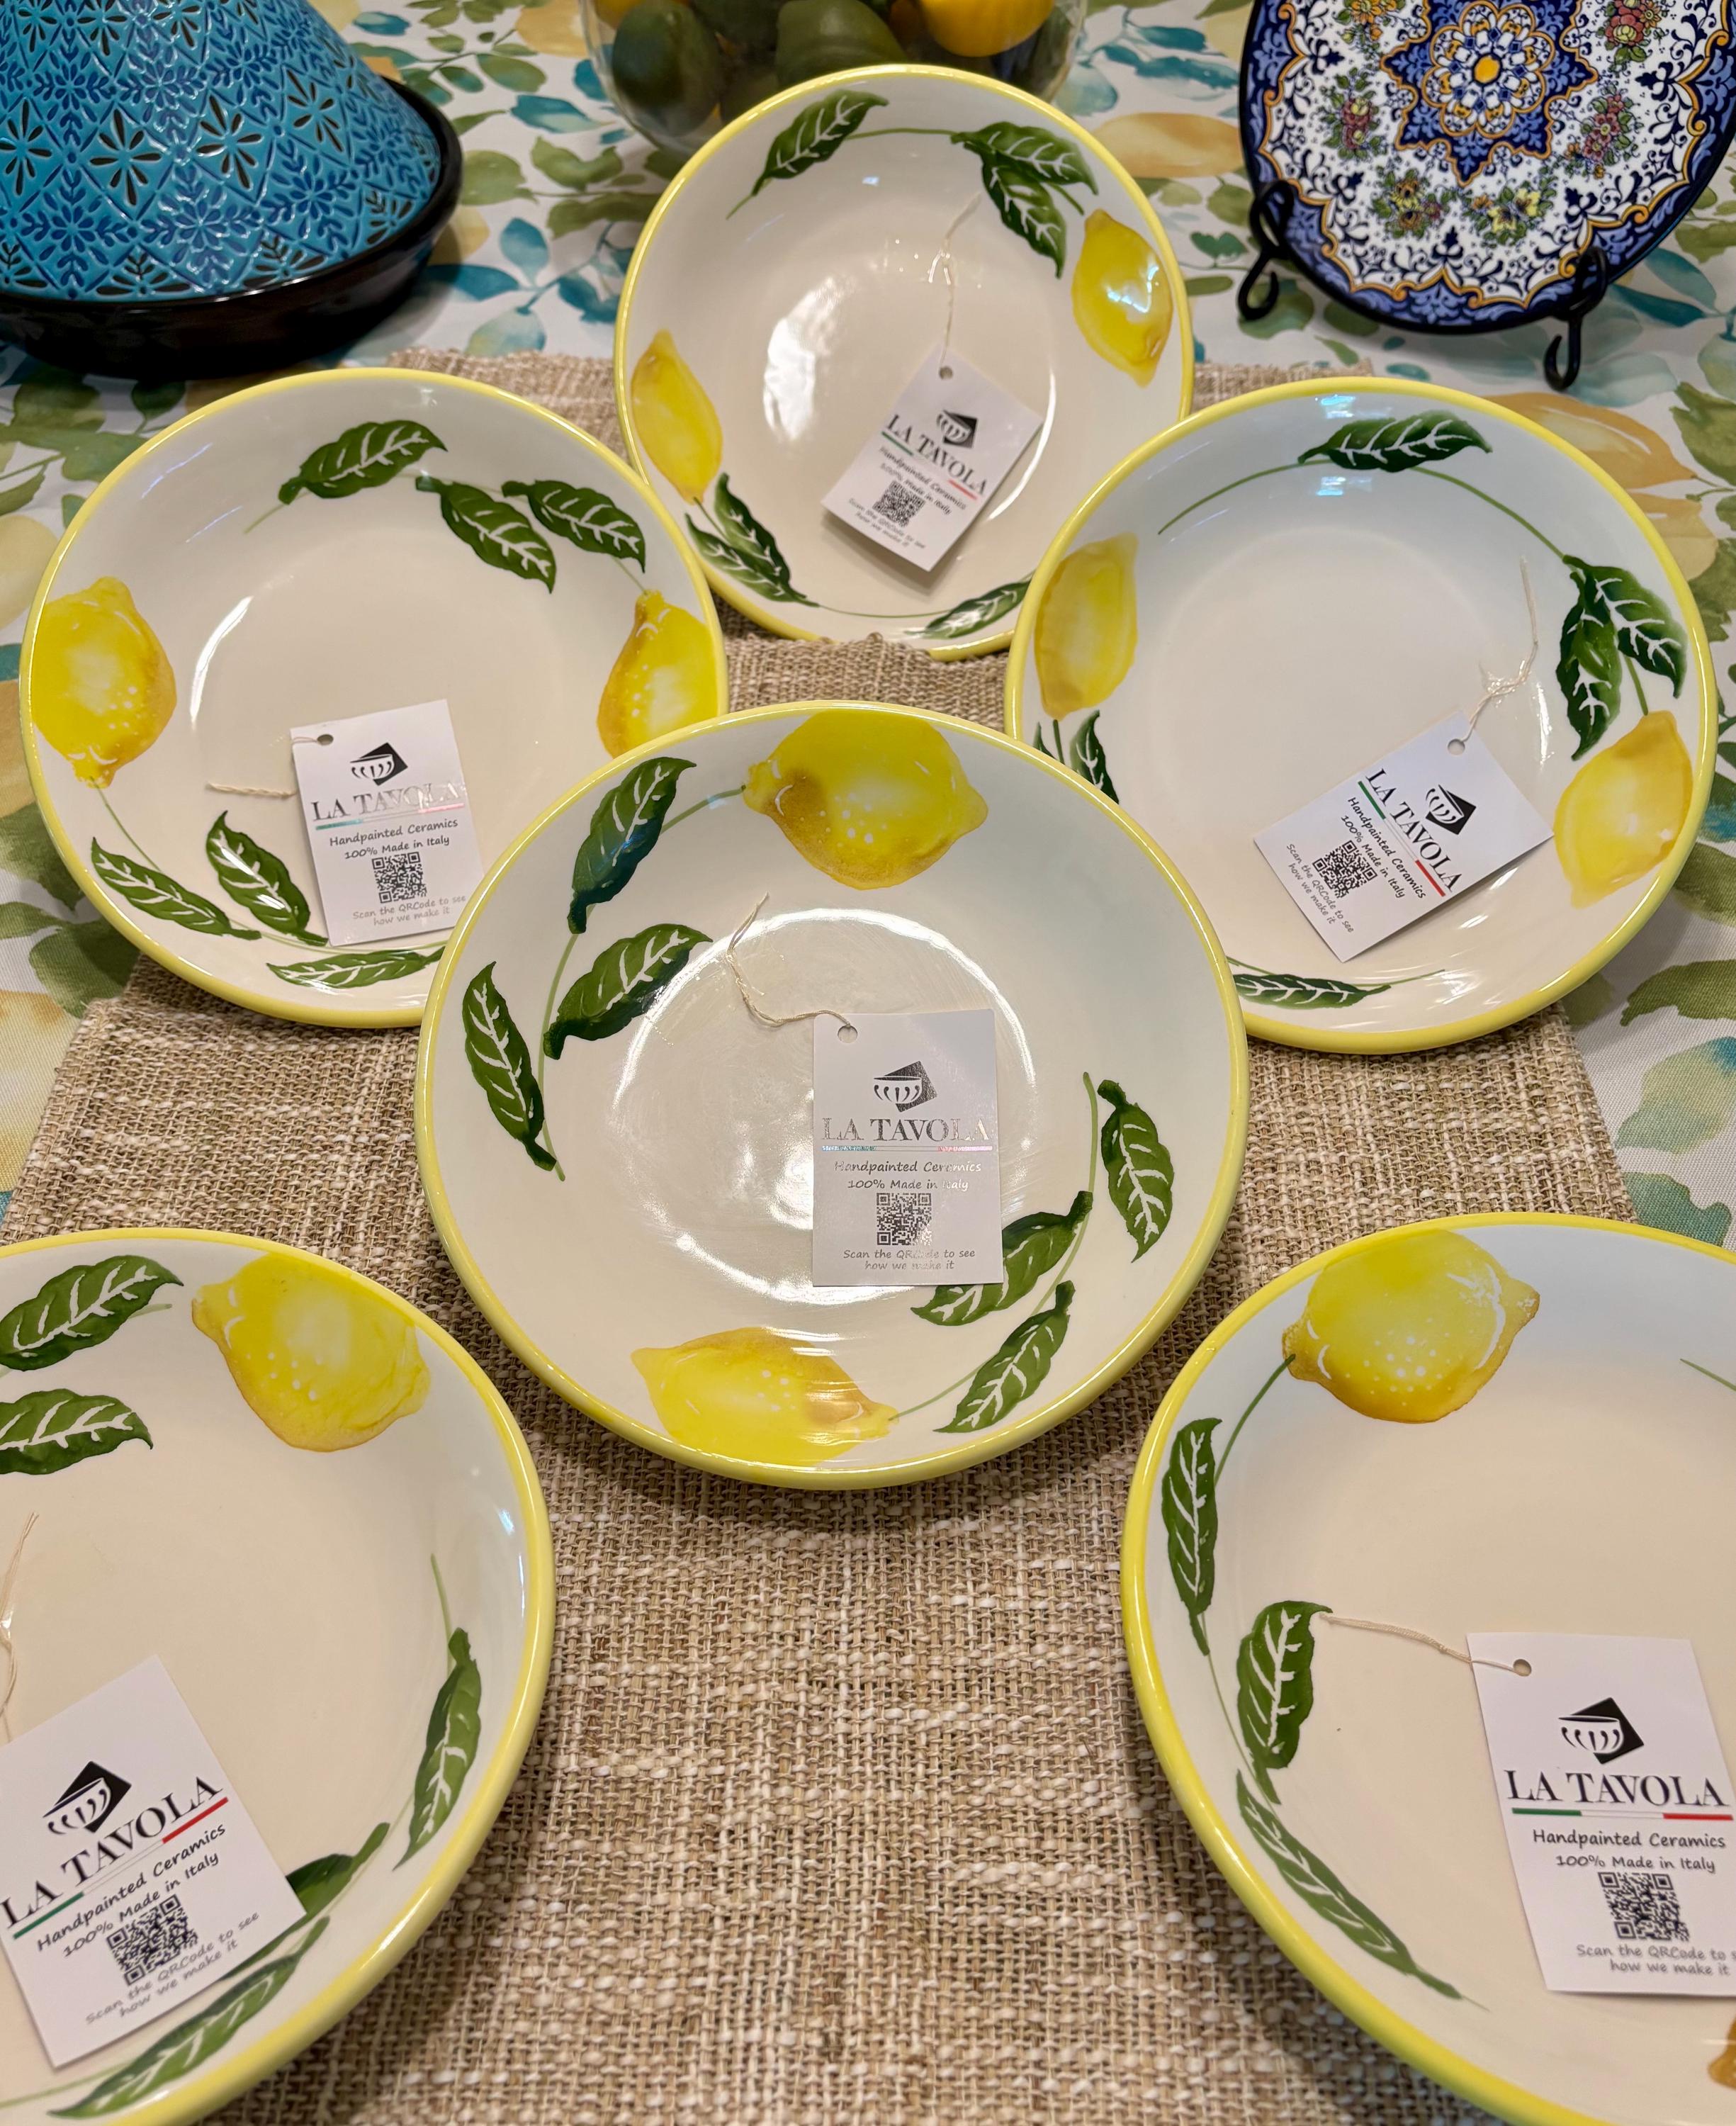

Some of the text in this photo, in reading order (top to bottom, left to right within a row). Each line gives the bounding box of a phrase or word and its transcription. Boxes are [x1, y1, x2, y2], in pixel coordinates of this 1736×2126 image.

[888, 414, 988, 495] LA TAVOLA
[310, 782, 459, 821] LA TAVOLA
[329, 819, 458, 846] Handpainted Ceramics
[1366, 768, 1462, 892] LA TAVOLA
[344, 836, 449, 859] 100% Made in Italy
[1341, 815, 1406, 899] 100% Made in Italy
[1348, 797, 1426, 899] Handpainted Ceramics
[1287, 843, 1354, 933] Scan the QRCode to see
[1288, 863, 1336, 924] how we make it
[353, 909, 376, 919] Scan
[399, 899, 435, 912] QRCode
[414, 909, 439, 919] make
[821, 1118, 991, 1142] LA TAVOLA
[835, 1161, 918, 1175] Handpainted
[847, 1179, 885, 1189] 100%
[890, 1179, 922, 1189] Made
[927, 1181, 937, 1189] in
[843, 1249, 870, 1259] Scan
[874, 1249, 891, 1259] the
[944, 1249, 954, 1258] to
[865, 1260, 888, 1270] how
[946, 1260, 954, 1269] it
[1503, 1769, 1730, 1808] LA TAVOLA
[0, 1776, 223, 1928] LA TAVOLA
[1533, 1828, 1726, 1849] Handpainted Ceramics
[1556, 1854, 1716, 1874] 100% Made in Italy
[38, 1823, 225, 1951] Handpainted Ceramics
[63, 1853, 220, 1957] 100% Made in Italy
[86, 1913, 259, 2025] Scan the QRCode to see
[1577, 1944, 1613, 1957] Scan
[1618, 1944, 1642, 1957] the
[1647, 1945, 1706, 1960] QRCode
[1710, 1949, 1726, 1961] to
[1610, 1959, 1730, 1976] how we make it
[118, 1939, 238, 2018] how we make it
